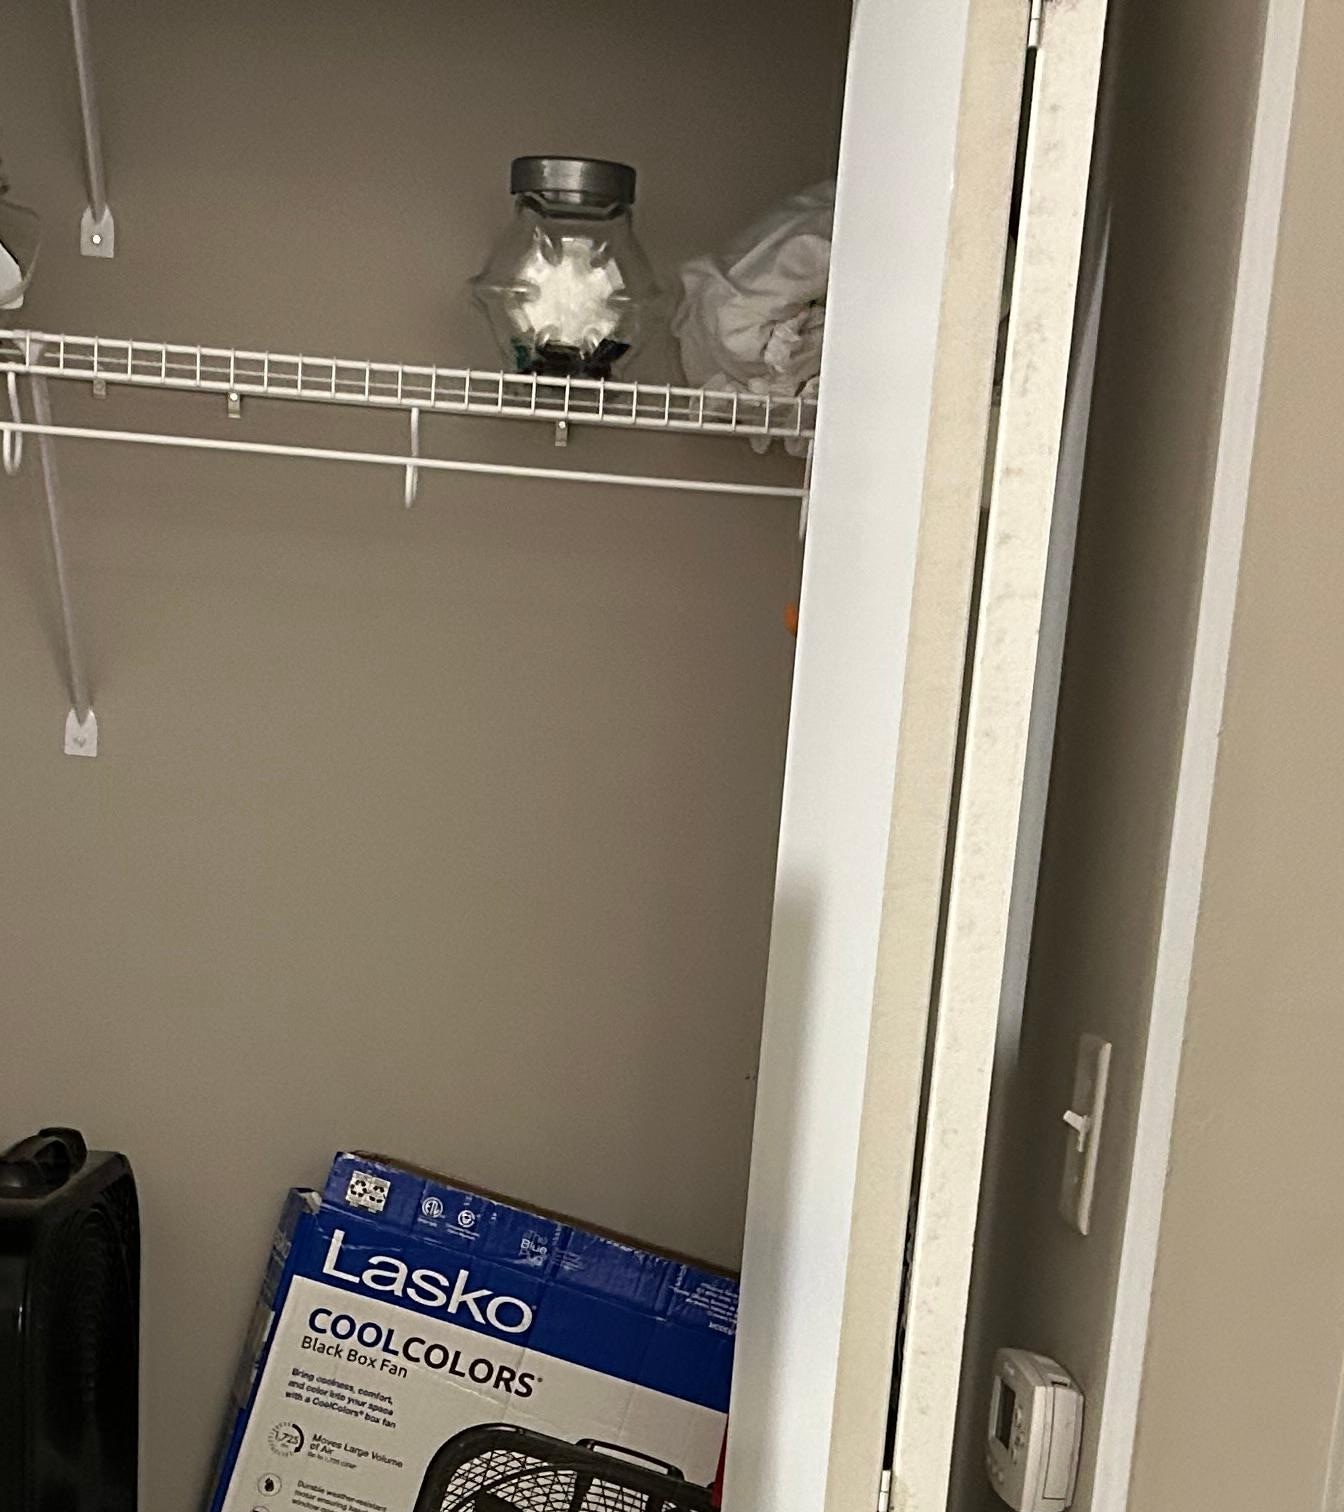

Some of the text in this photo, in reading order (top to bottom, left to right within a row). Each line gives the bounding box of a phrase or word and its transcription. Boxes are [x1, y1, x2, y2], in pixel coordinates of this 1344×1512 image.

[520, 1237, 549, 1257] Blue
[322, 1228, 534, 1334] Lasko
[301, 1335, 408, 1379] Black Box Fan
[309, 1308, 535, 1398] COOLCOLORS
[288, 1380, 394, 1416] and color into your space
[292, 1368, 315, 1382] Bring
[358, 1388, 394, 1405] comfort,
[285, 1391, 303, 1402] with
[365, 1412, 380, 1424] box
[382, 1417, 397, 1429] fan
[310, 1441, 321, 1451] of
[312, 1433, 343, 1450] Moves
[344, 1443, 370, 1458] Large
[371, 1449, 404, 1468] Volume
